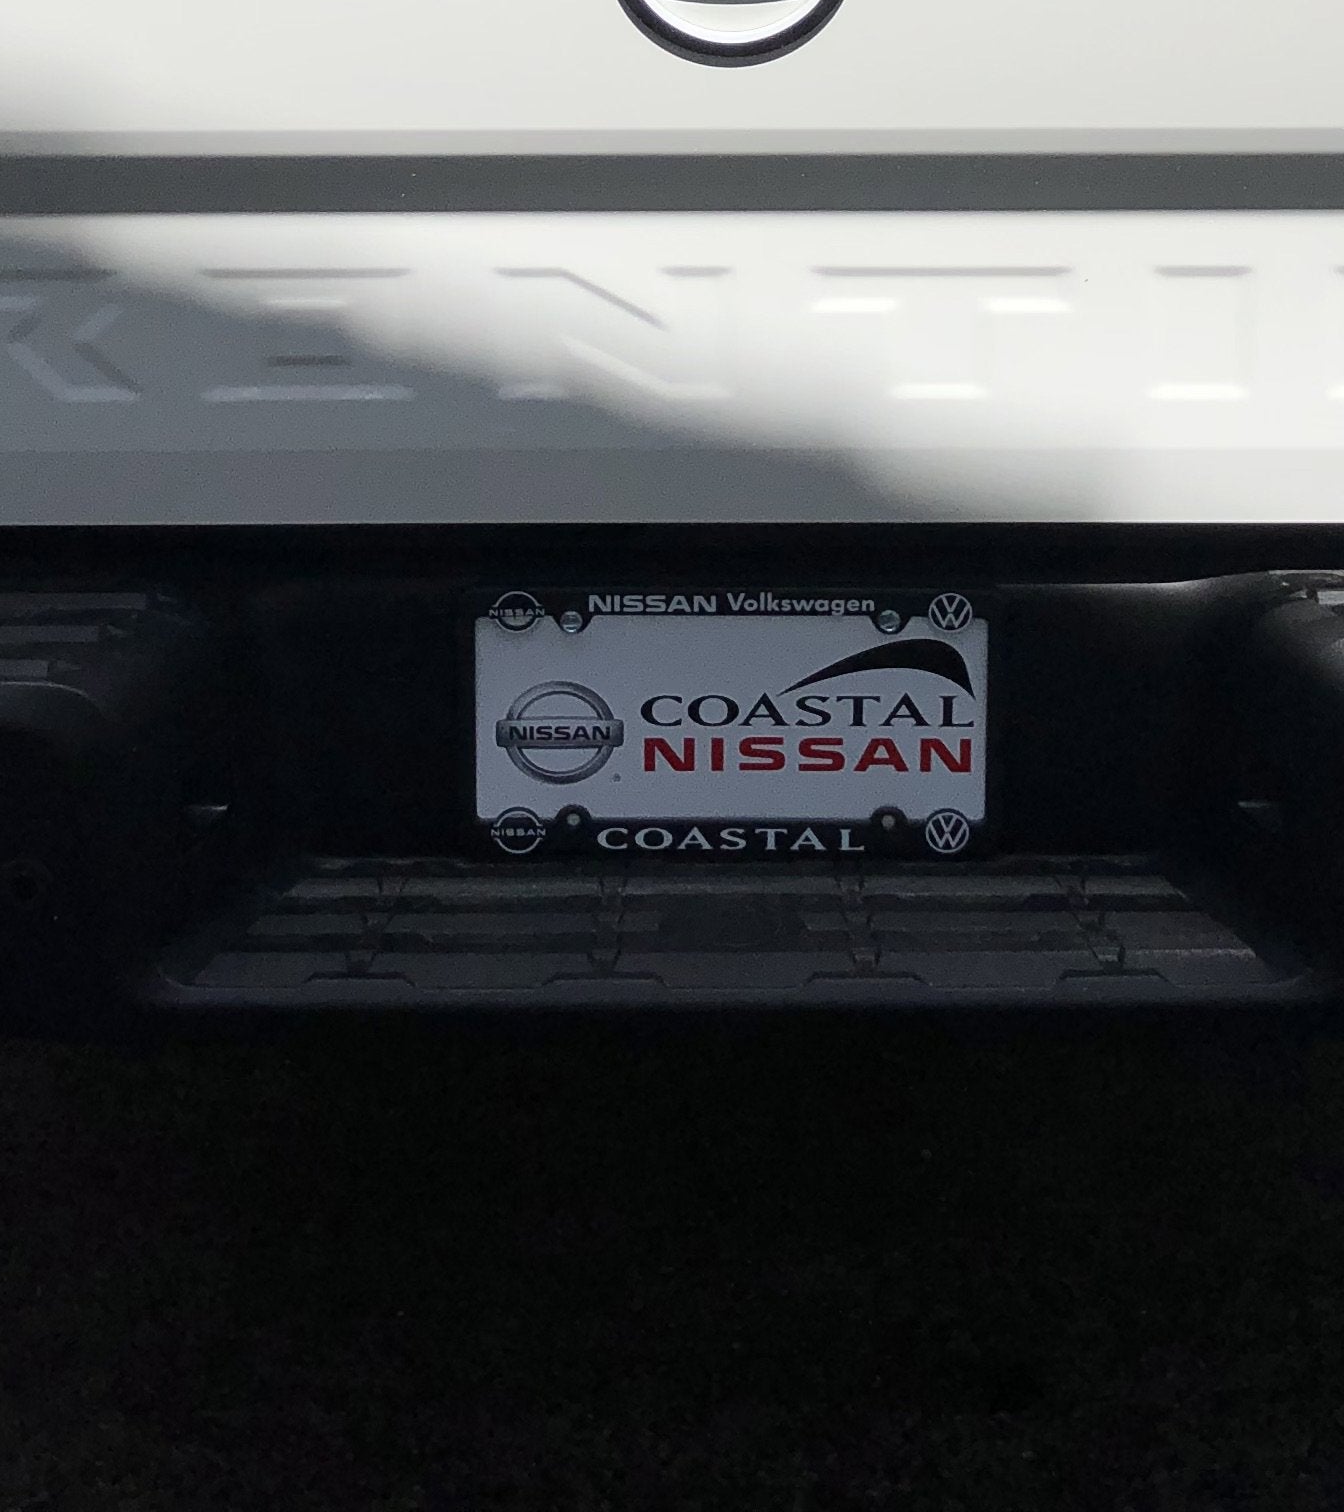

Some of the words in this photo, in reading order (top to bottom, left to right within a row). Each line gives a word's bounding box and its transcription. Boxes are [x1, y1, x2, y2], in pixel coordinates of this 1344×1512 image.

[488, 607, 546, 618] NISSAN
[588, 593, 718, 614] NISSAN
[726, 592, 876, 616] Volkswagen
[640, 691, 975, 728] COASTAL
[508, 724, 611, 741] NISSAN
[643, 736, 972, 773] NISSAN
[490, 827, 546, 837] NISSAN
[596, 826, 865, 851] COASTAL
